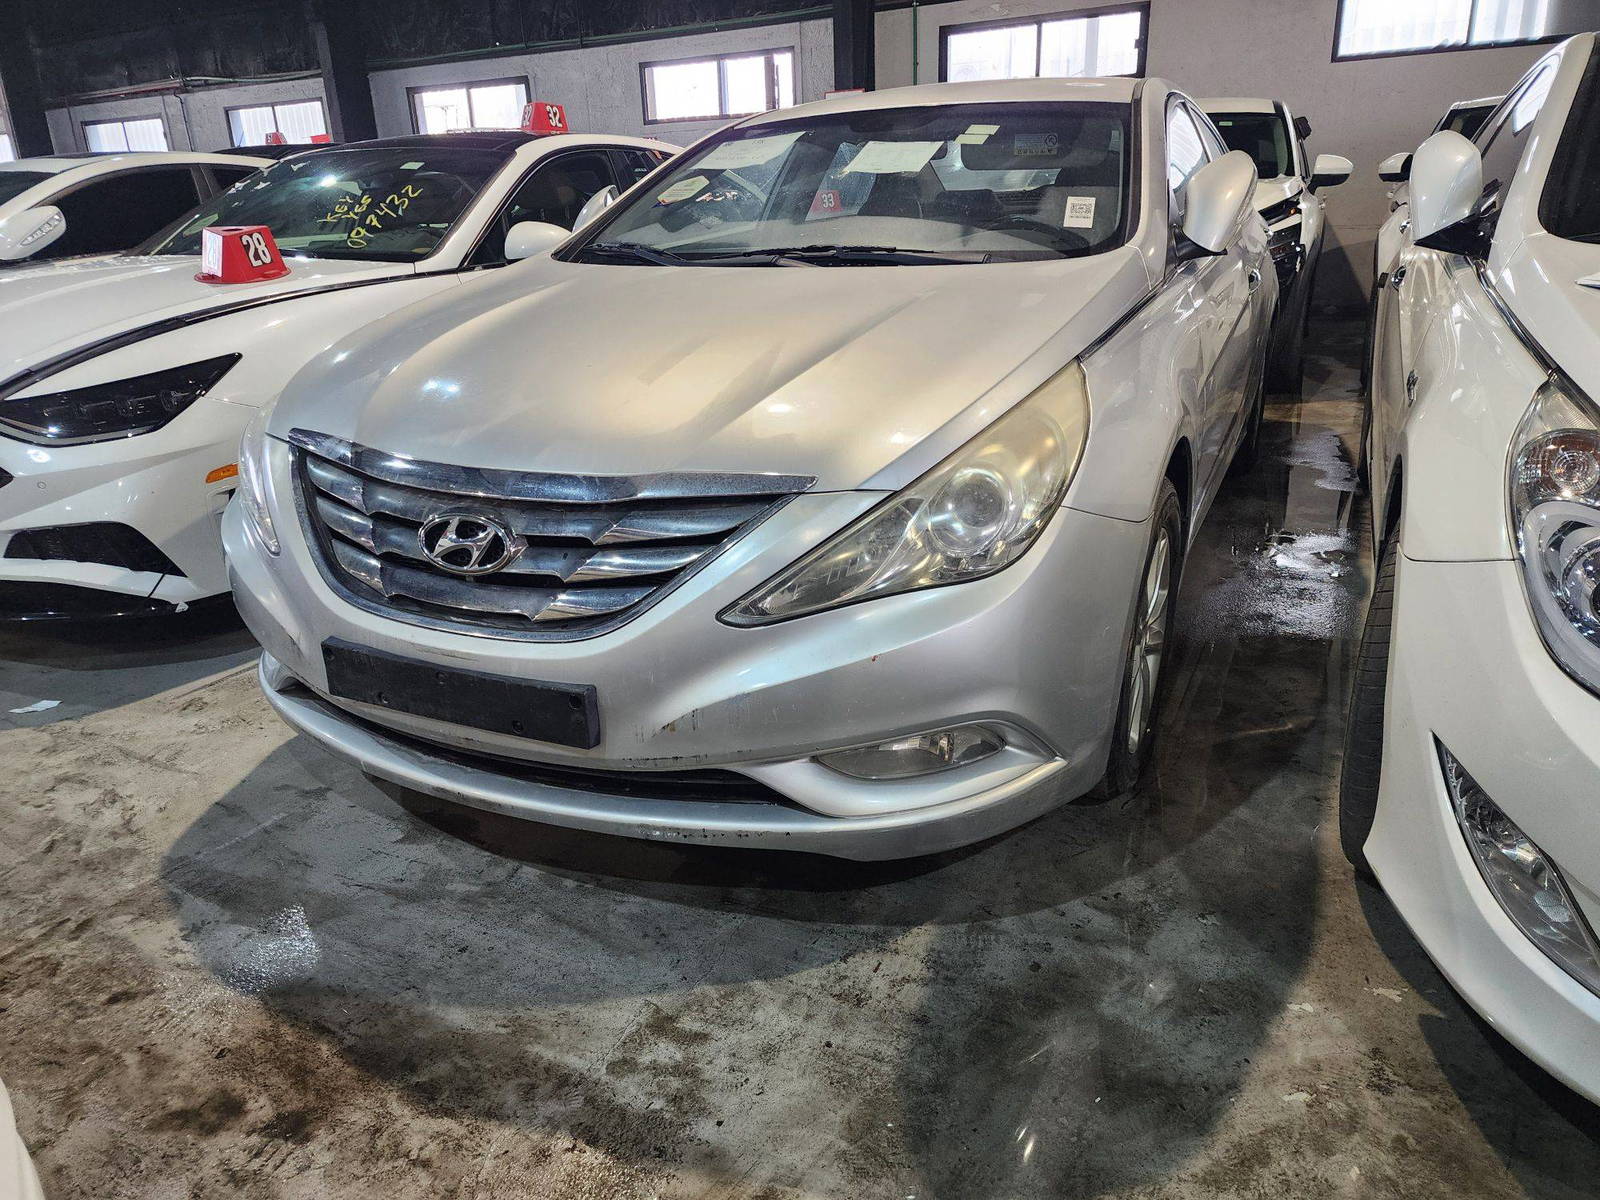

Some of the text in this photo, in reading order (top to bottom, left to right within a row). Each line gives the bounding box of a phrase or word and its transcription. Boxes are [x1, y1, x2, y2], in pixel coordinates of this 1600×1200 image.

[546, 105, 563, 128] 32
[317, 196, 354, 222] KEY
[341, 195, 372, 220] YES
[821, 193, 835, 208] 33
[347, 184, 424, 249] 097432
[241, 232, 272, 267] 28
